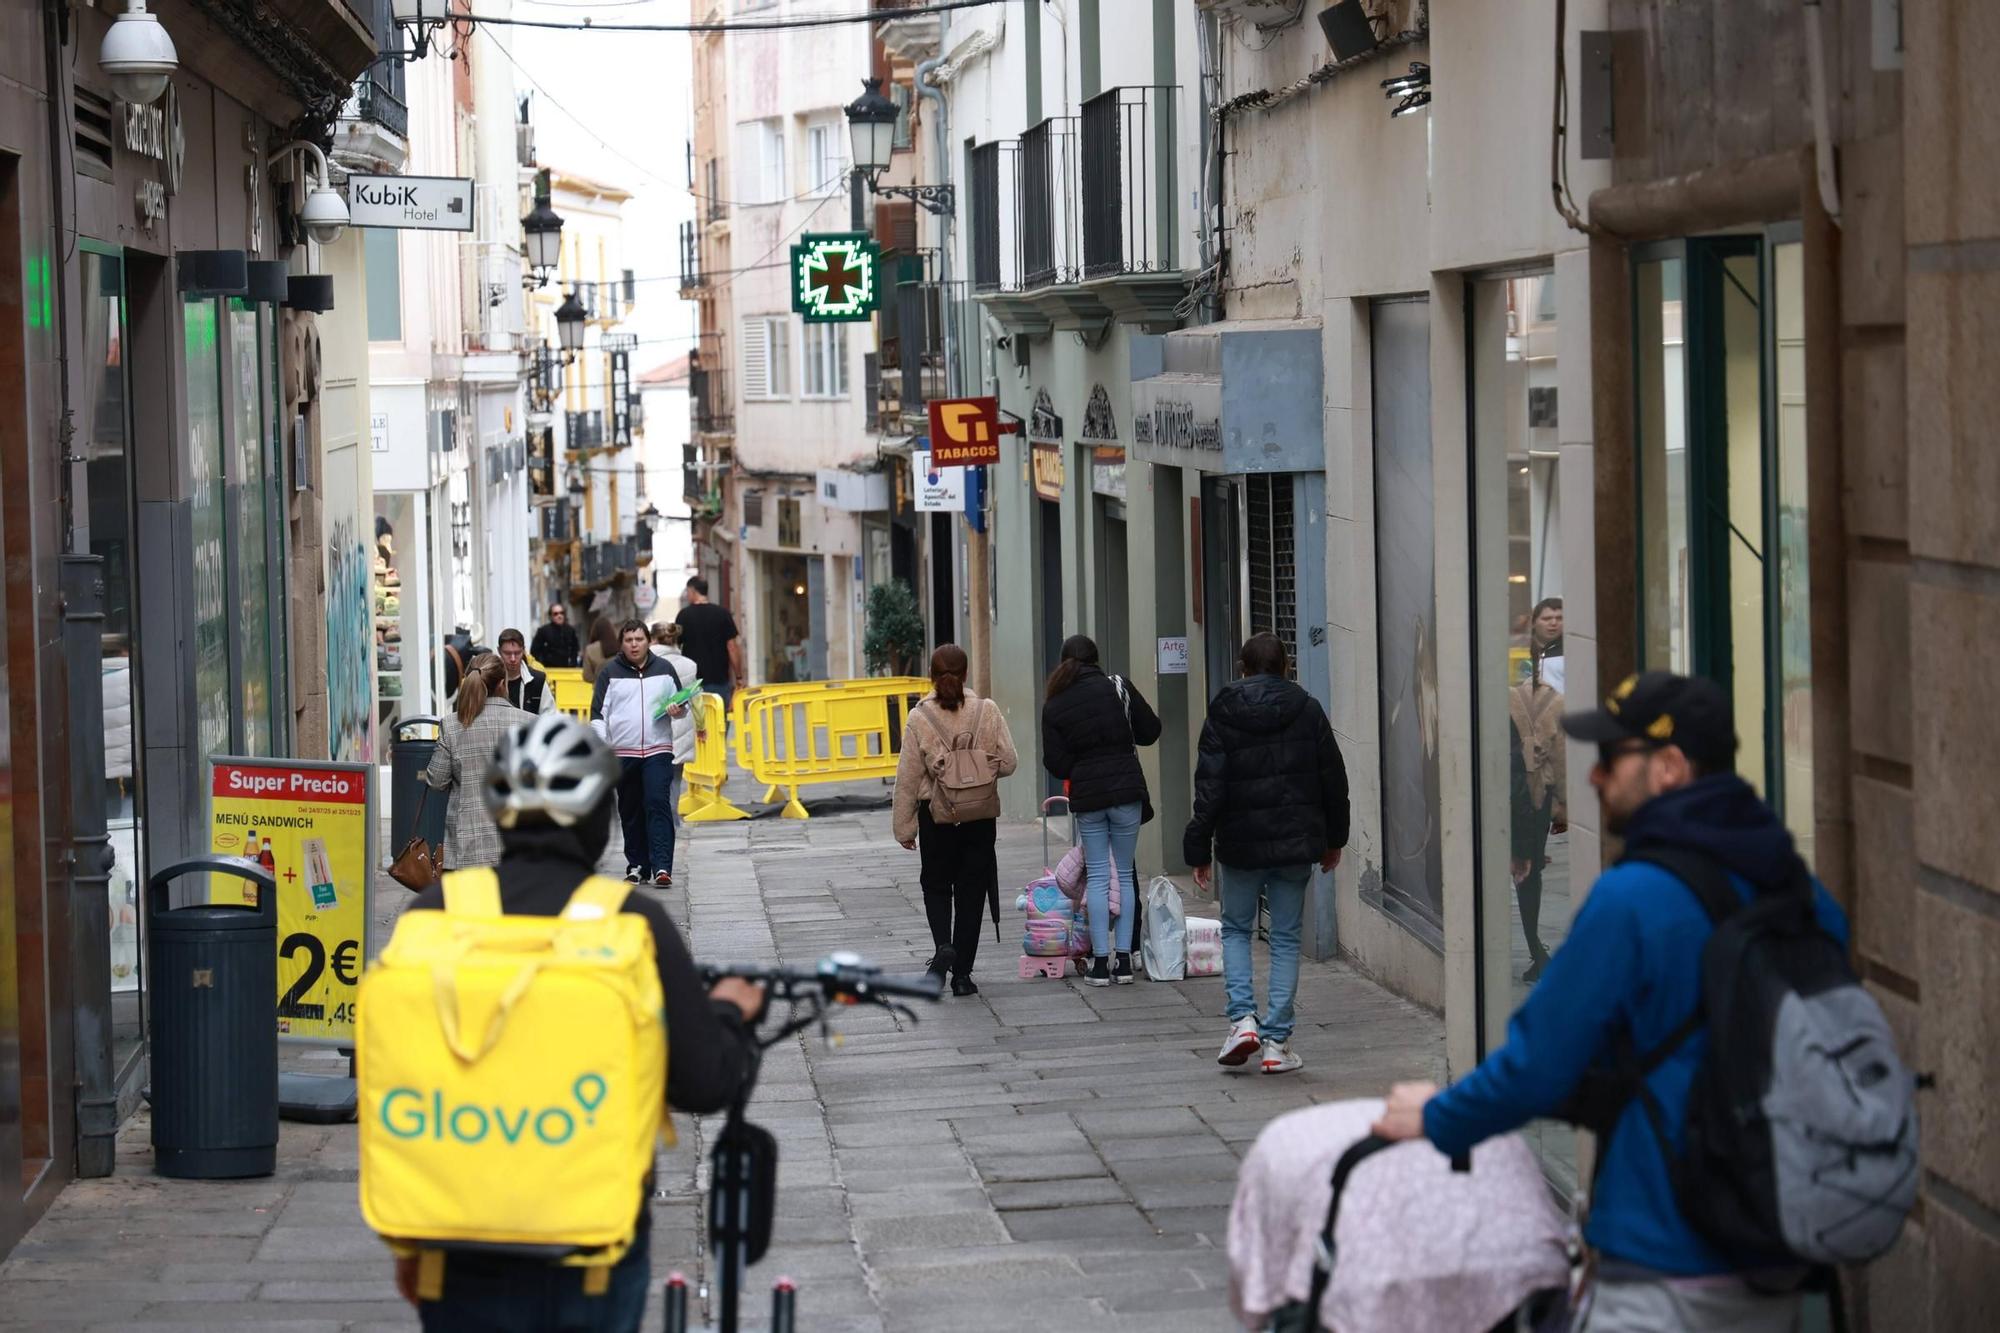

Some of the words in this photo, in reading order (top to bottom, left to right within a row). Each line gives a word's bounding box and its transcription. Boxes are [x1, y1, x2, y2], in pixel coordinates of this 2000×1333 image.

[355, 184, 418, 207] KubiK
[404, 207, 438, 221] Hotel
[935, 445, 998, 460] TABACOS
[1163, 641, 1185, 651] Arte
[229, 770, 286, 794] Super
[290, 773, 349, 795] Precio
[216, 812, 249, 826] MENÚ
[251, 815, 314, 829] SANDWICH
[380, 1087, 576, 1147] Glovo
